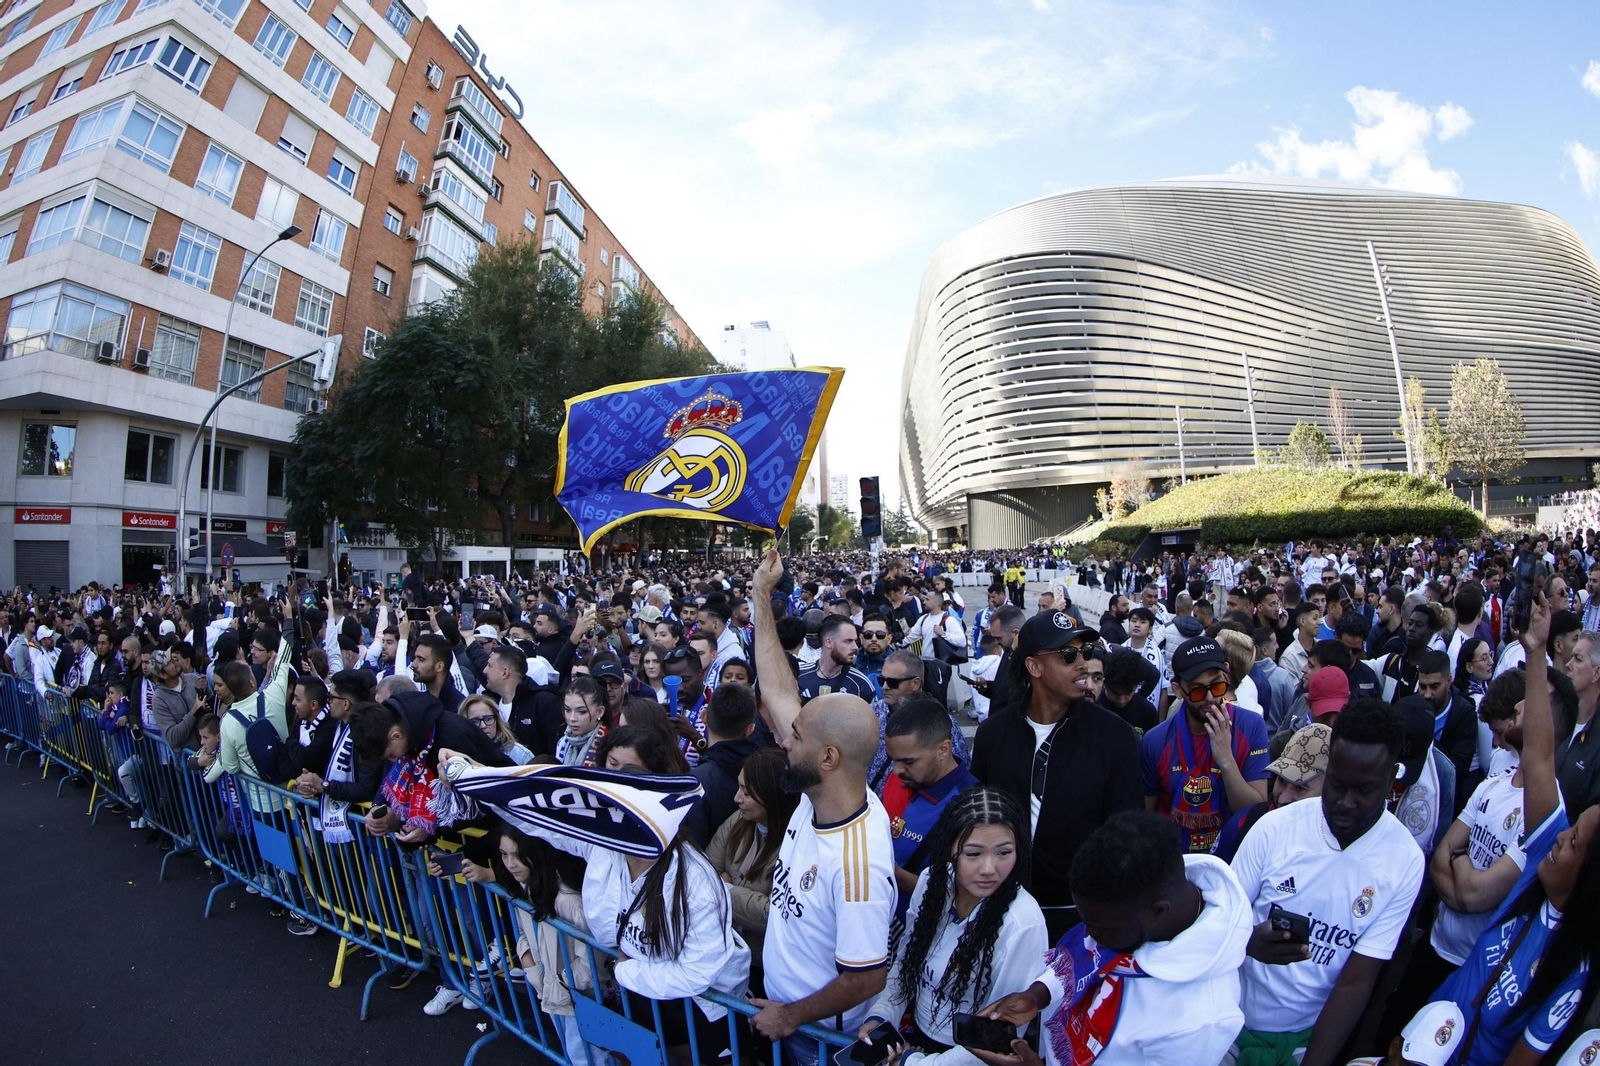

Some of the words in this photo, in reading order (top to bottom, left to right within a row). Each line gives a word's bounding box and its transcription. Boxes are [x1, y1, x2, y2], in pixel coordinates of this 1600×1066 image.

[30, 512, 64, 522] Santander
[138, 516, 170, 527] Santander
[1186, 644, 1215, 656] MILANO
[902, 828, 923, 842] 1999
[1276, 886, 1297, 894] adidas
[1486, 945, 1501, 967] FLY
